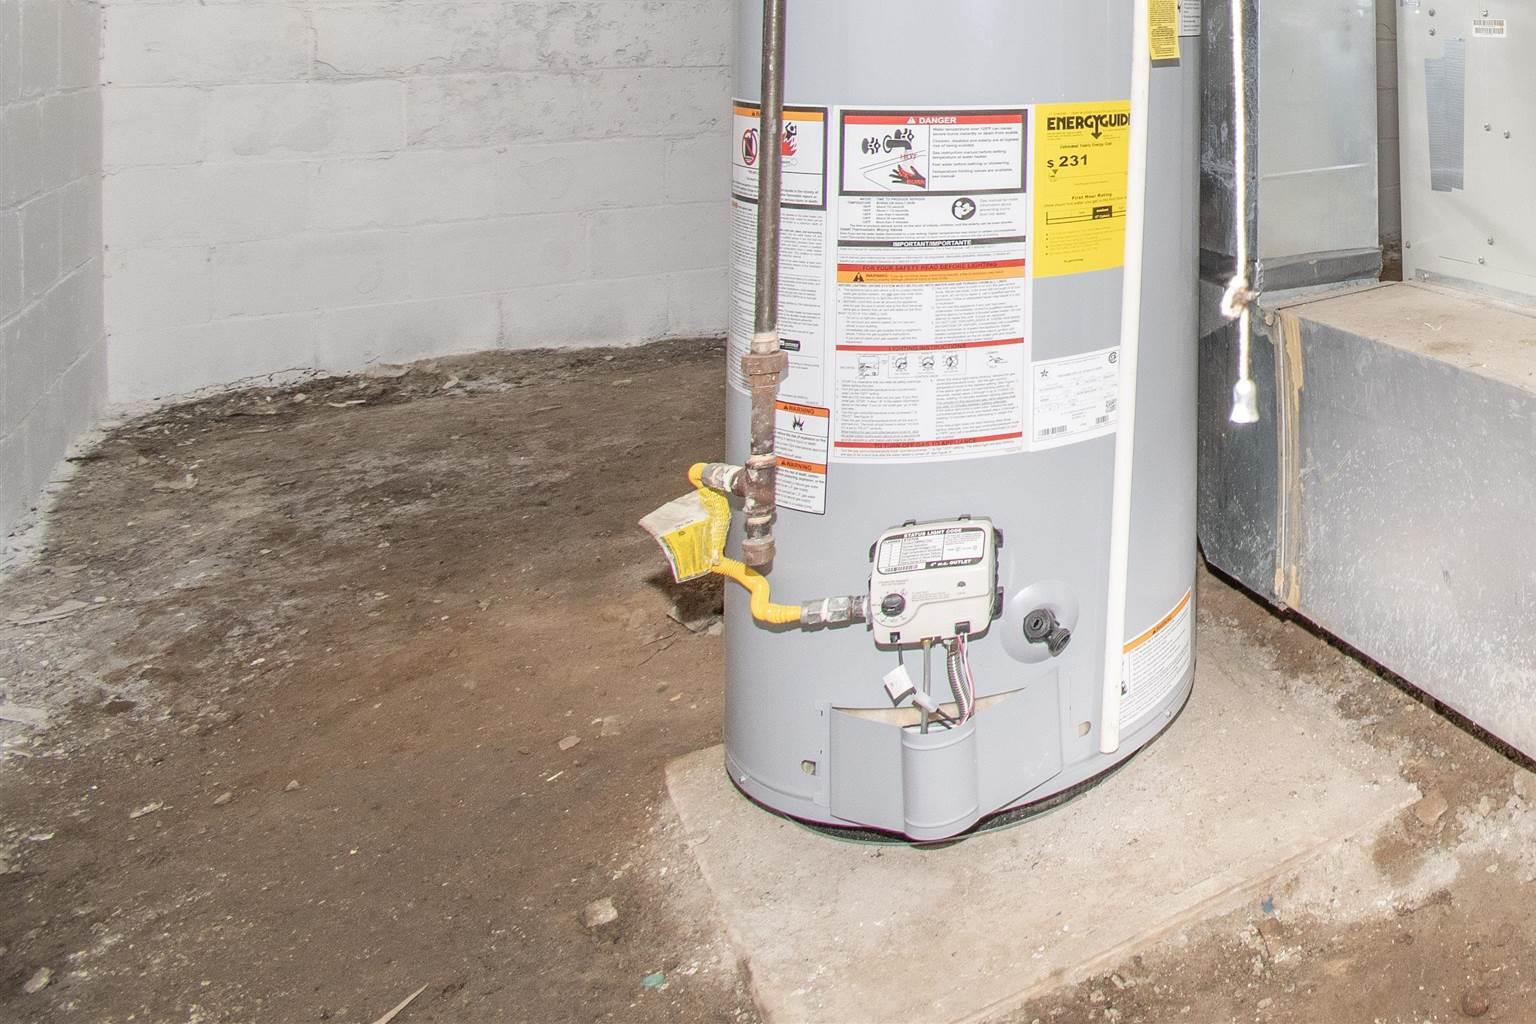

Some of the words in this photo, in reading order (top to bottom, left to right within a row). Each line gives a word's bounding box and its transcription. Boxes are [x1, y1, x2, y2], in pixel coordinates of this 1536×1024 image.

[919, 116, 957, 125] DANGER
[1058, 154, 1088, 167] 231
[786, 461, 812, 471] WARNING
[904, 530, 926, 538] STATUS
